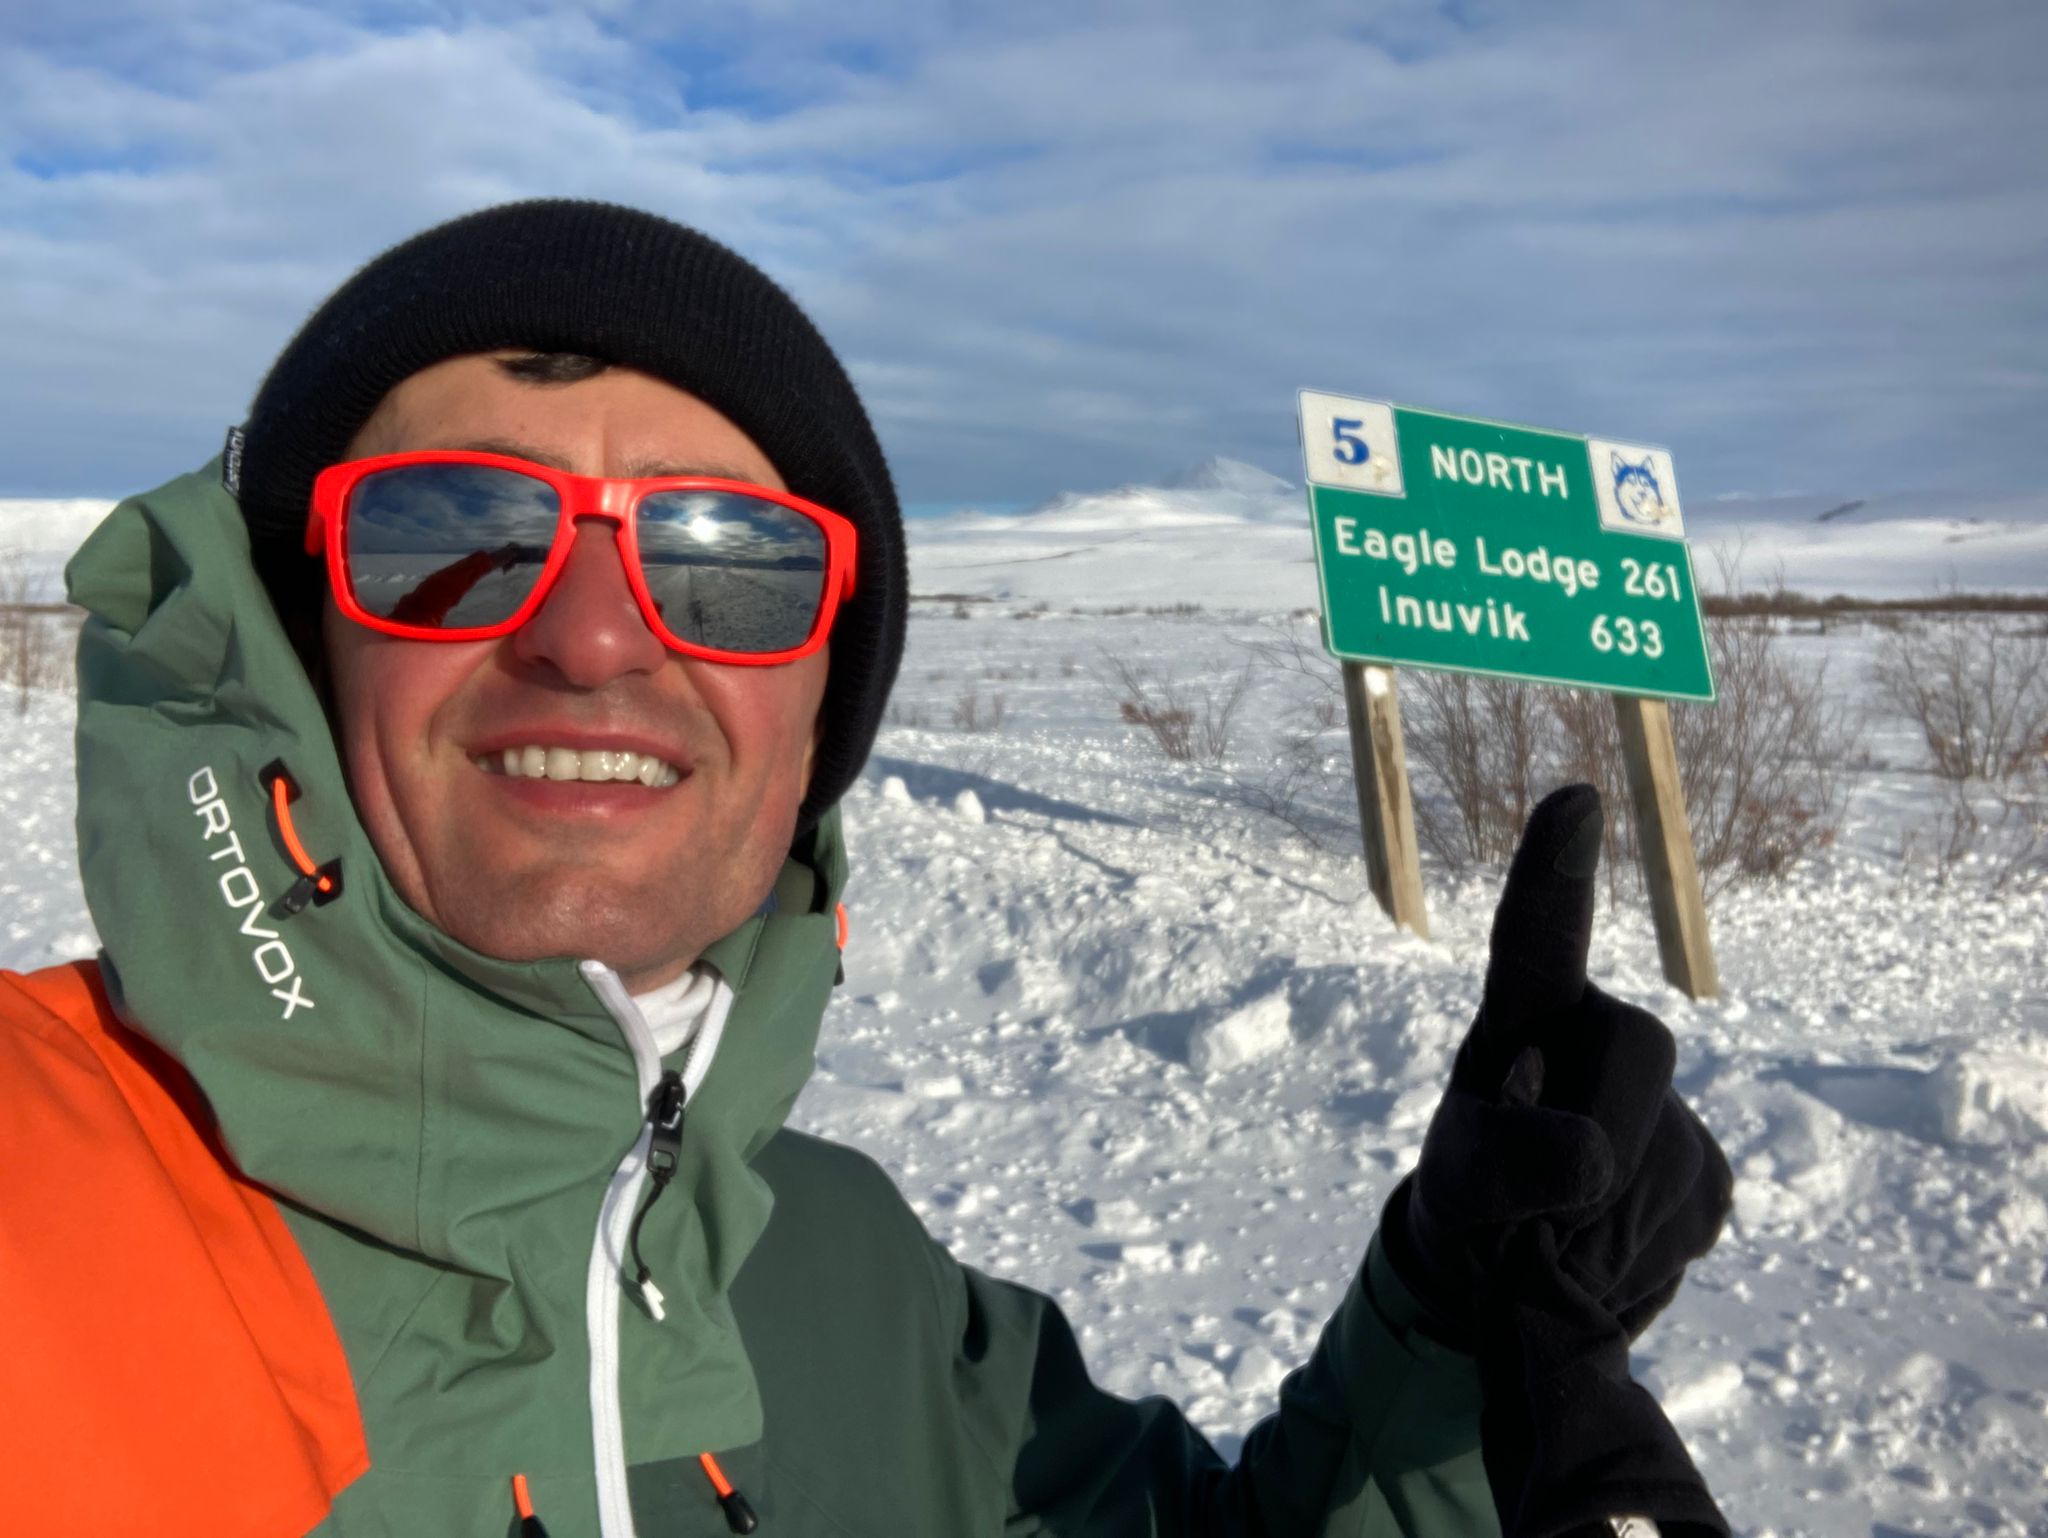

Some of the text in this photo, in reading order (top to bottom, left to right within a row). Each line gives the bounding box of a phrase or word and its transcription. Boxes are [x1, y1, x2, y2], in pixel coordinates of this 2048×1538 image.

[1332, 417, 1370, 465] 5
[1430, 443, 1569, 499] NORTH
[1334, 515, 1681, 602] Eagle Lodge 261
[1379, 585, 1665, 659] Inuvik 633
[188, 765, 315, 1020] ORTOVOX
